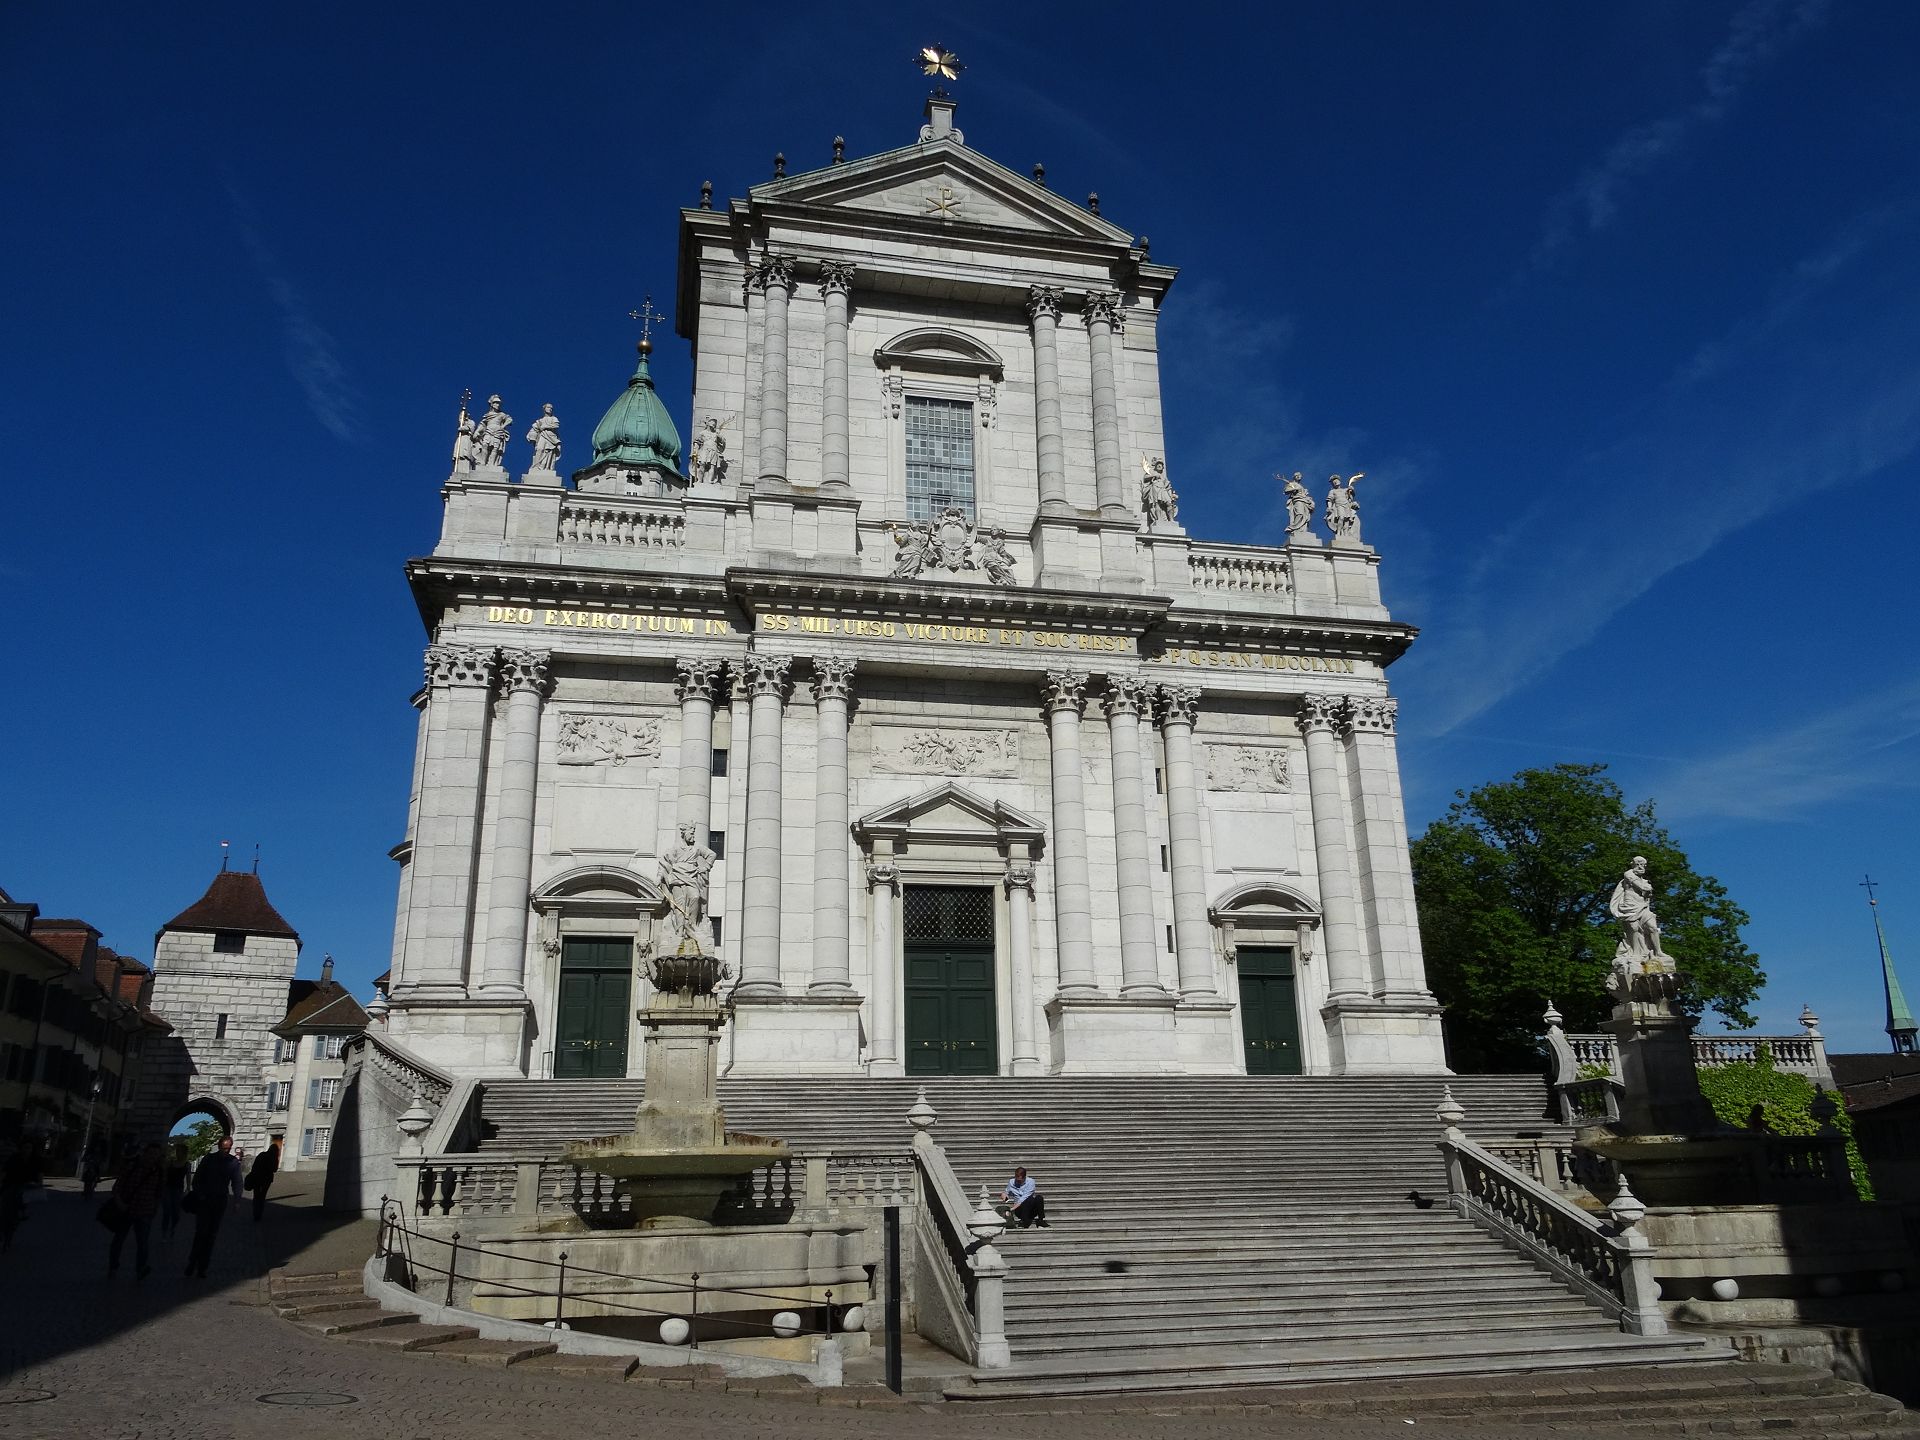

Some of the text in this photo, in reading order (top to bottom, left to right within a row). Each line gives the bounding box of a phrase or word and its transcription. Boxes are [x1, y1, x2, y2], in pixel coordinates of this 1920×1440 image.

[488, 606, 728, 636] DEO EXERCITUUM IN
[844, 619, 895, 638] URSO
[903, 623, 990, 644] VICTORE
[1000, 629, 1025, 646] ET
